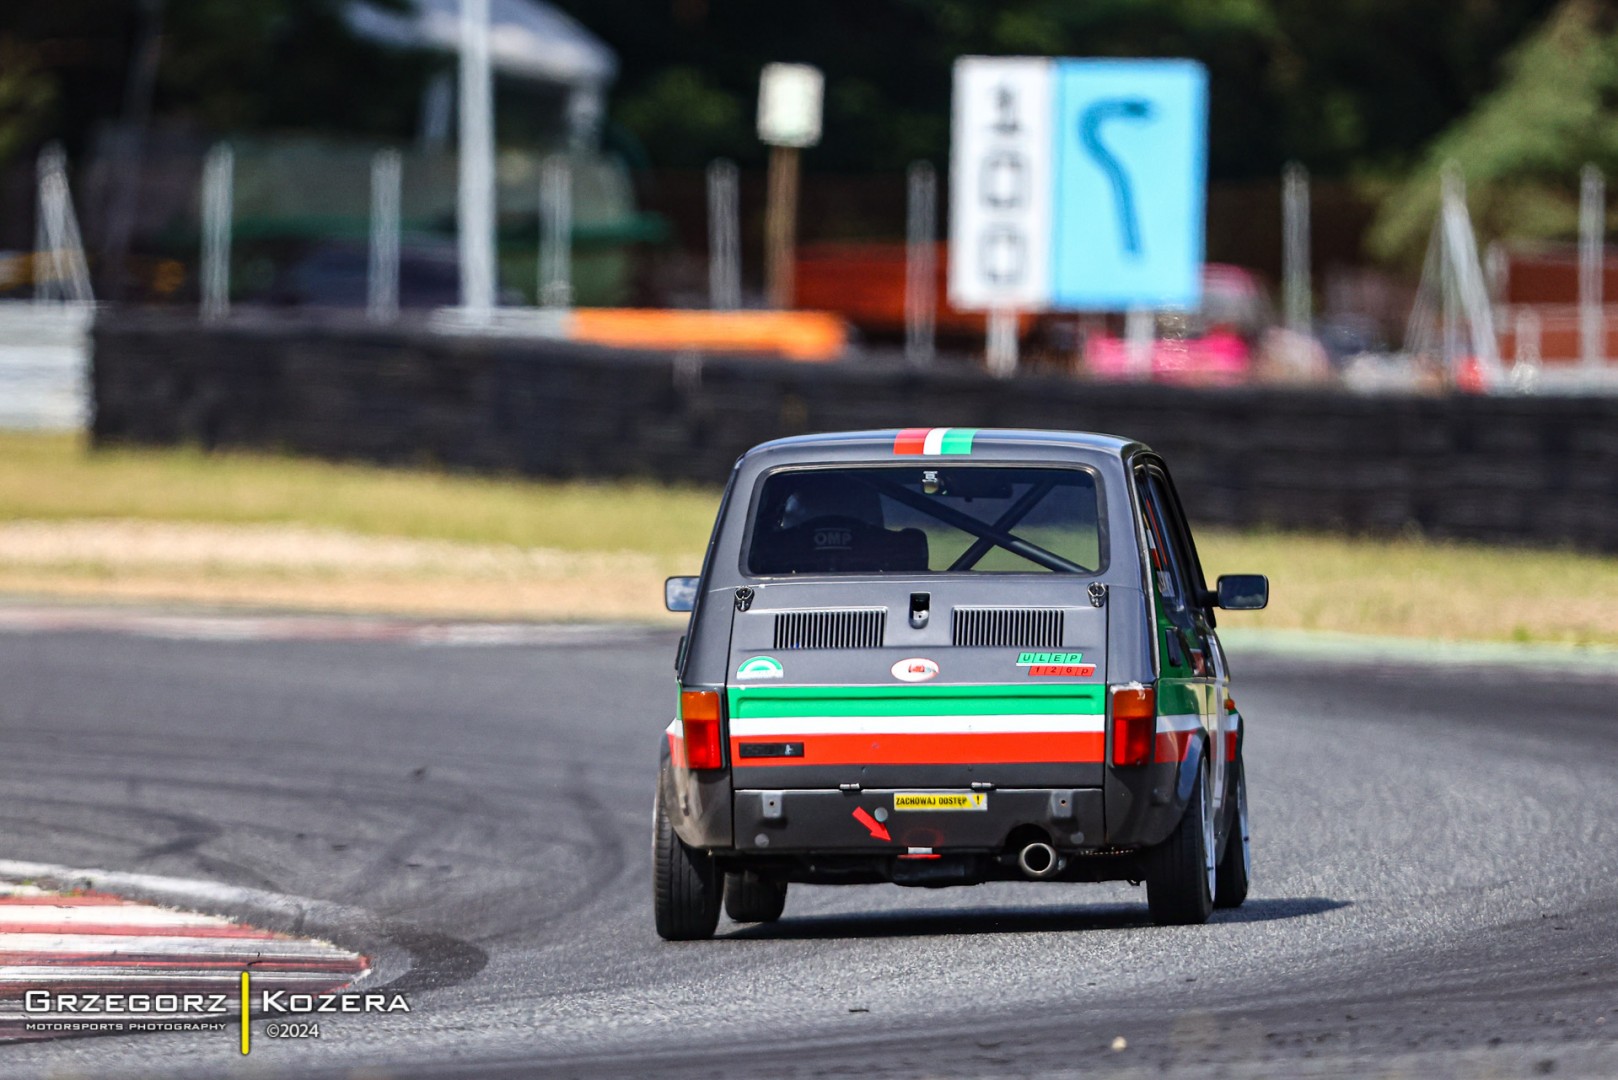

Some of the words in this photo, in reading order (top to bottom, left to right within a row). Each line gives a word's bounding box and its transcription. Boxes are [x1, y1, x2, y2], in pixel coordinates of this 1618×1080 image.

[979, 84, 1032, 285] 100
[813, 532, 853, 546] OMP
[1023, 654, 1078, 662] ULEP
[895, 797, 936, 806] ZACHOWAJ
